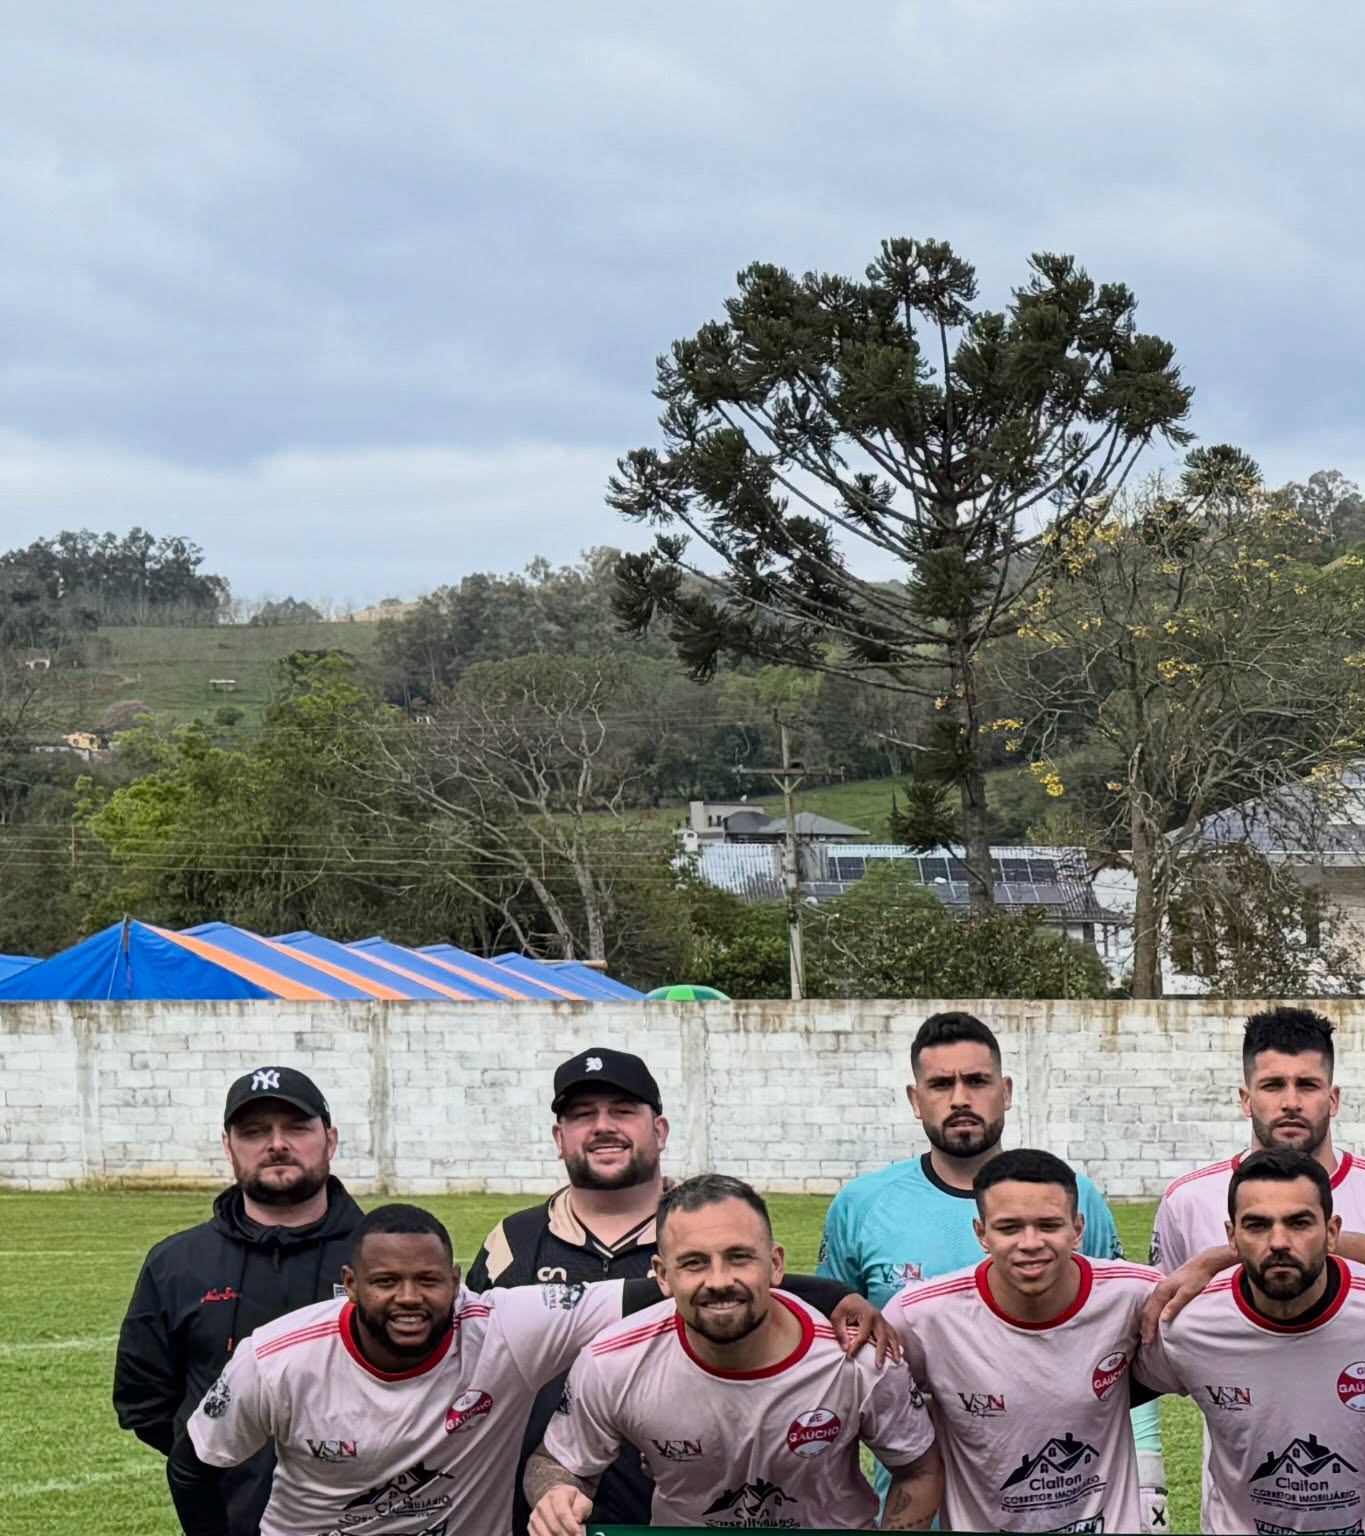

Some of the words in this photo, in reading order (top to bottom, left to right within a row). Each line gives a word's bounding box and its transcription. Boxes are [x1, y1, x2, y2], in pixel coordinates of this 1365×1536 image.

[251, 1070, 280, 1091] NY
[957, 1392, 1006, 1412] VSN
[788, 1425, 840, 1443] GAÚCHO
[304, 1439, 358, 1458] VSN
[1275, 1477, 1329, 1492] Claiton
